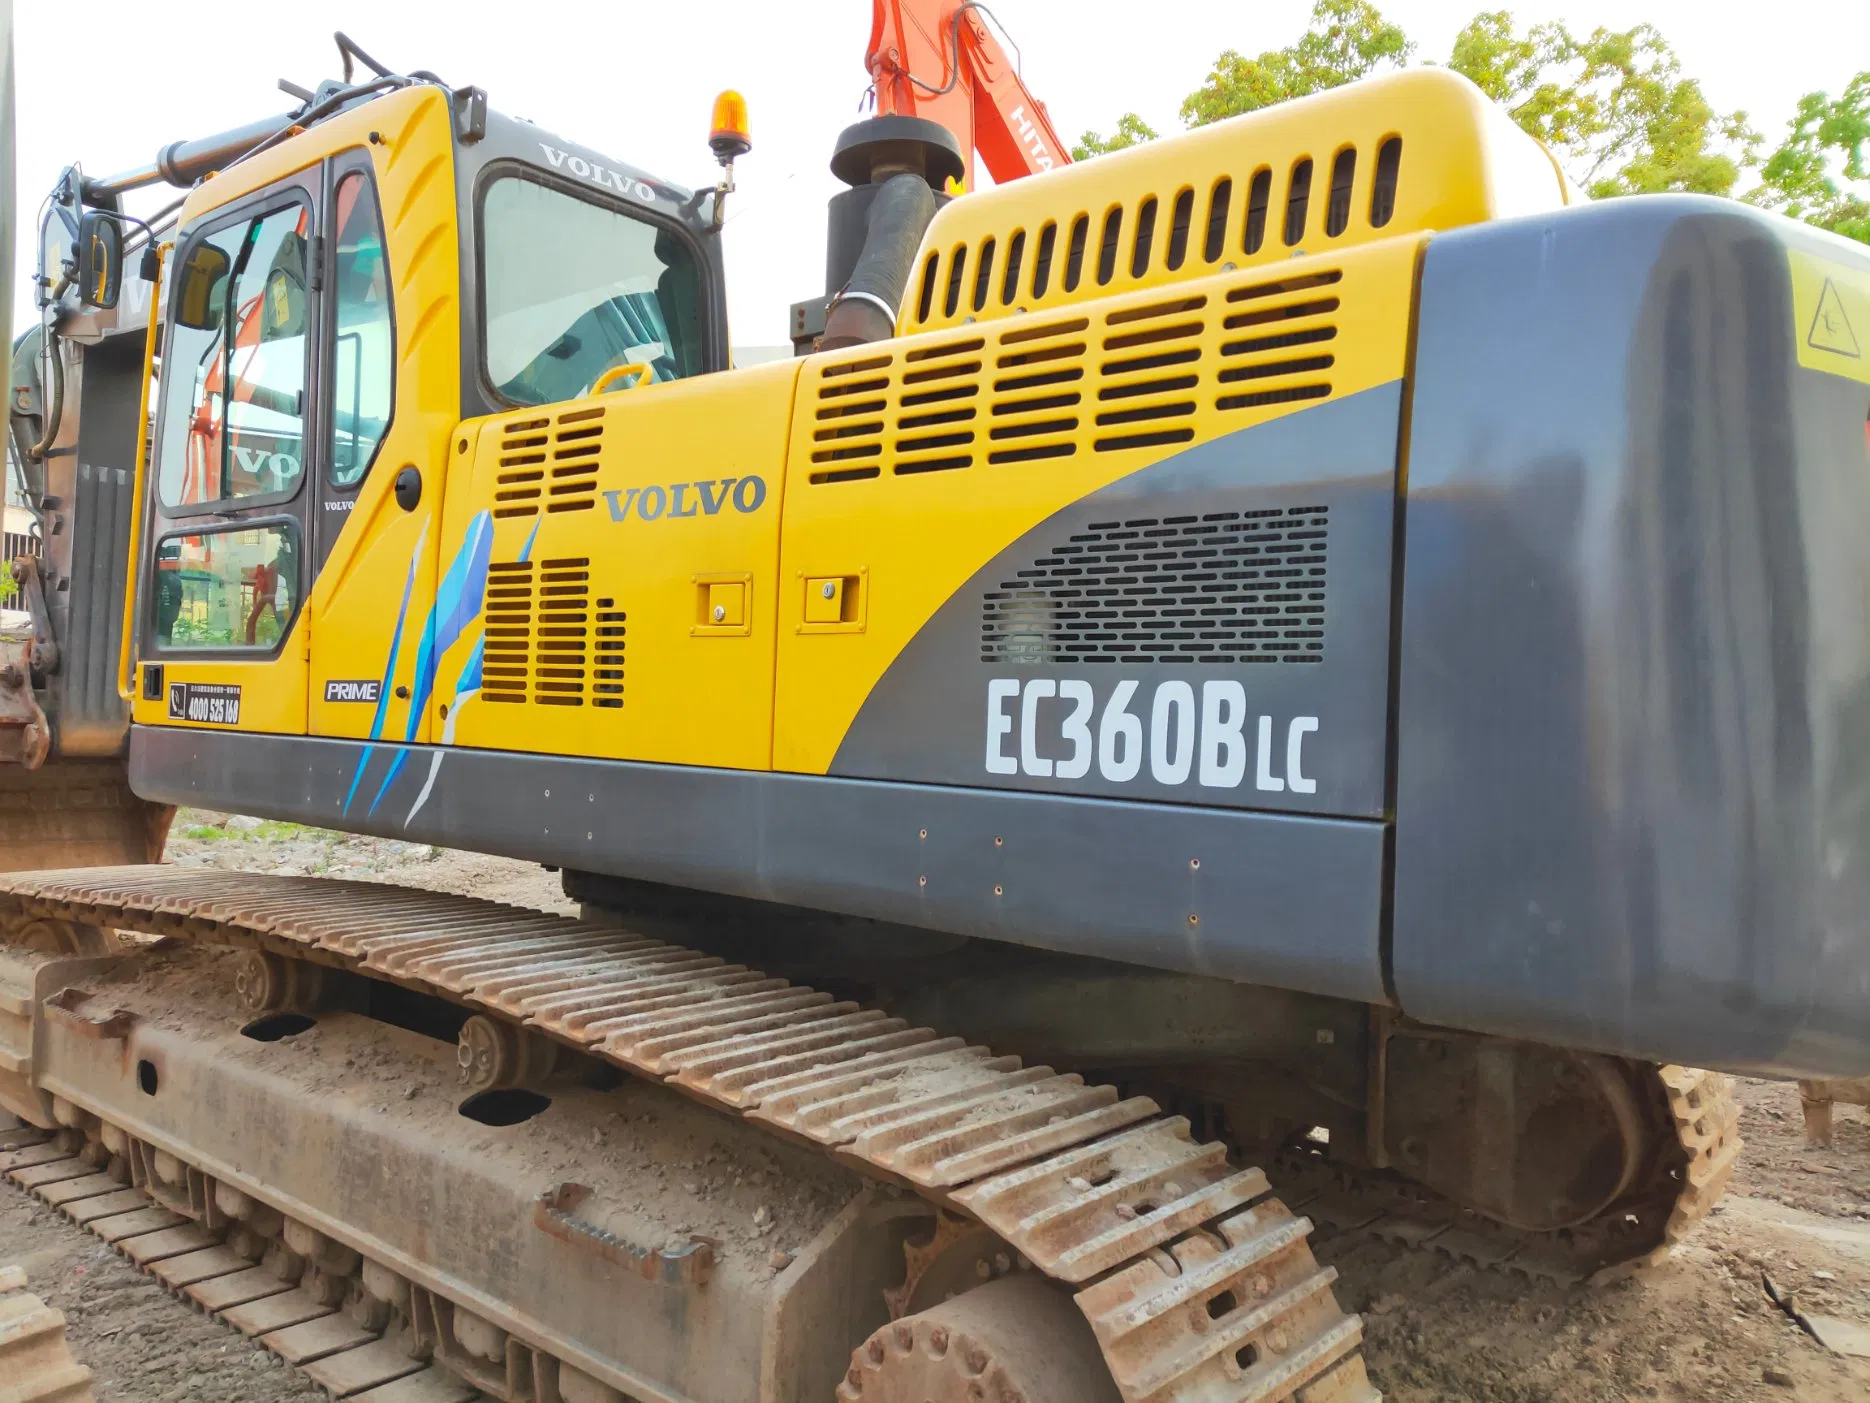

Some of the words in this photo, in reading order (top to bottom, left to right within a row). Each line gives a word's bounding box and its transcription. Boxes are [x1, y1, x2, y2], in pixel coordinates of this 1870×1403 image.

[538, 142, 656, 202] VOLVO
[324, 501, 355, 511] VOLVO
[602, 474, 767, 523] VOLVO
[327, 682, 378, 700] PRIME
[188, 696, 209, 721] 4000
[209, 698, 225, 722] 525
